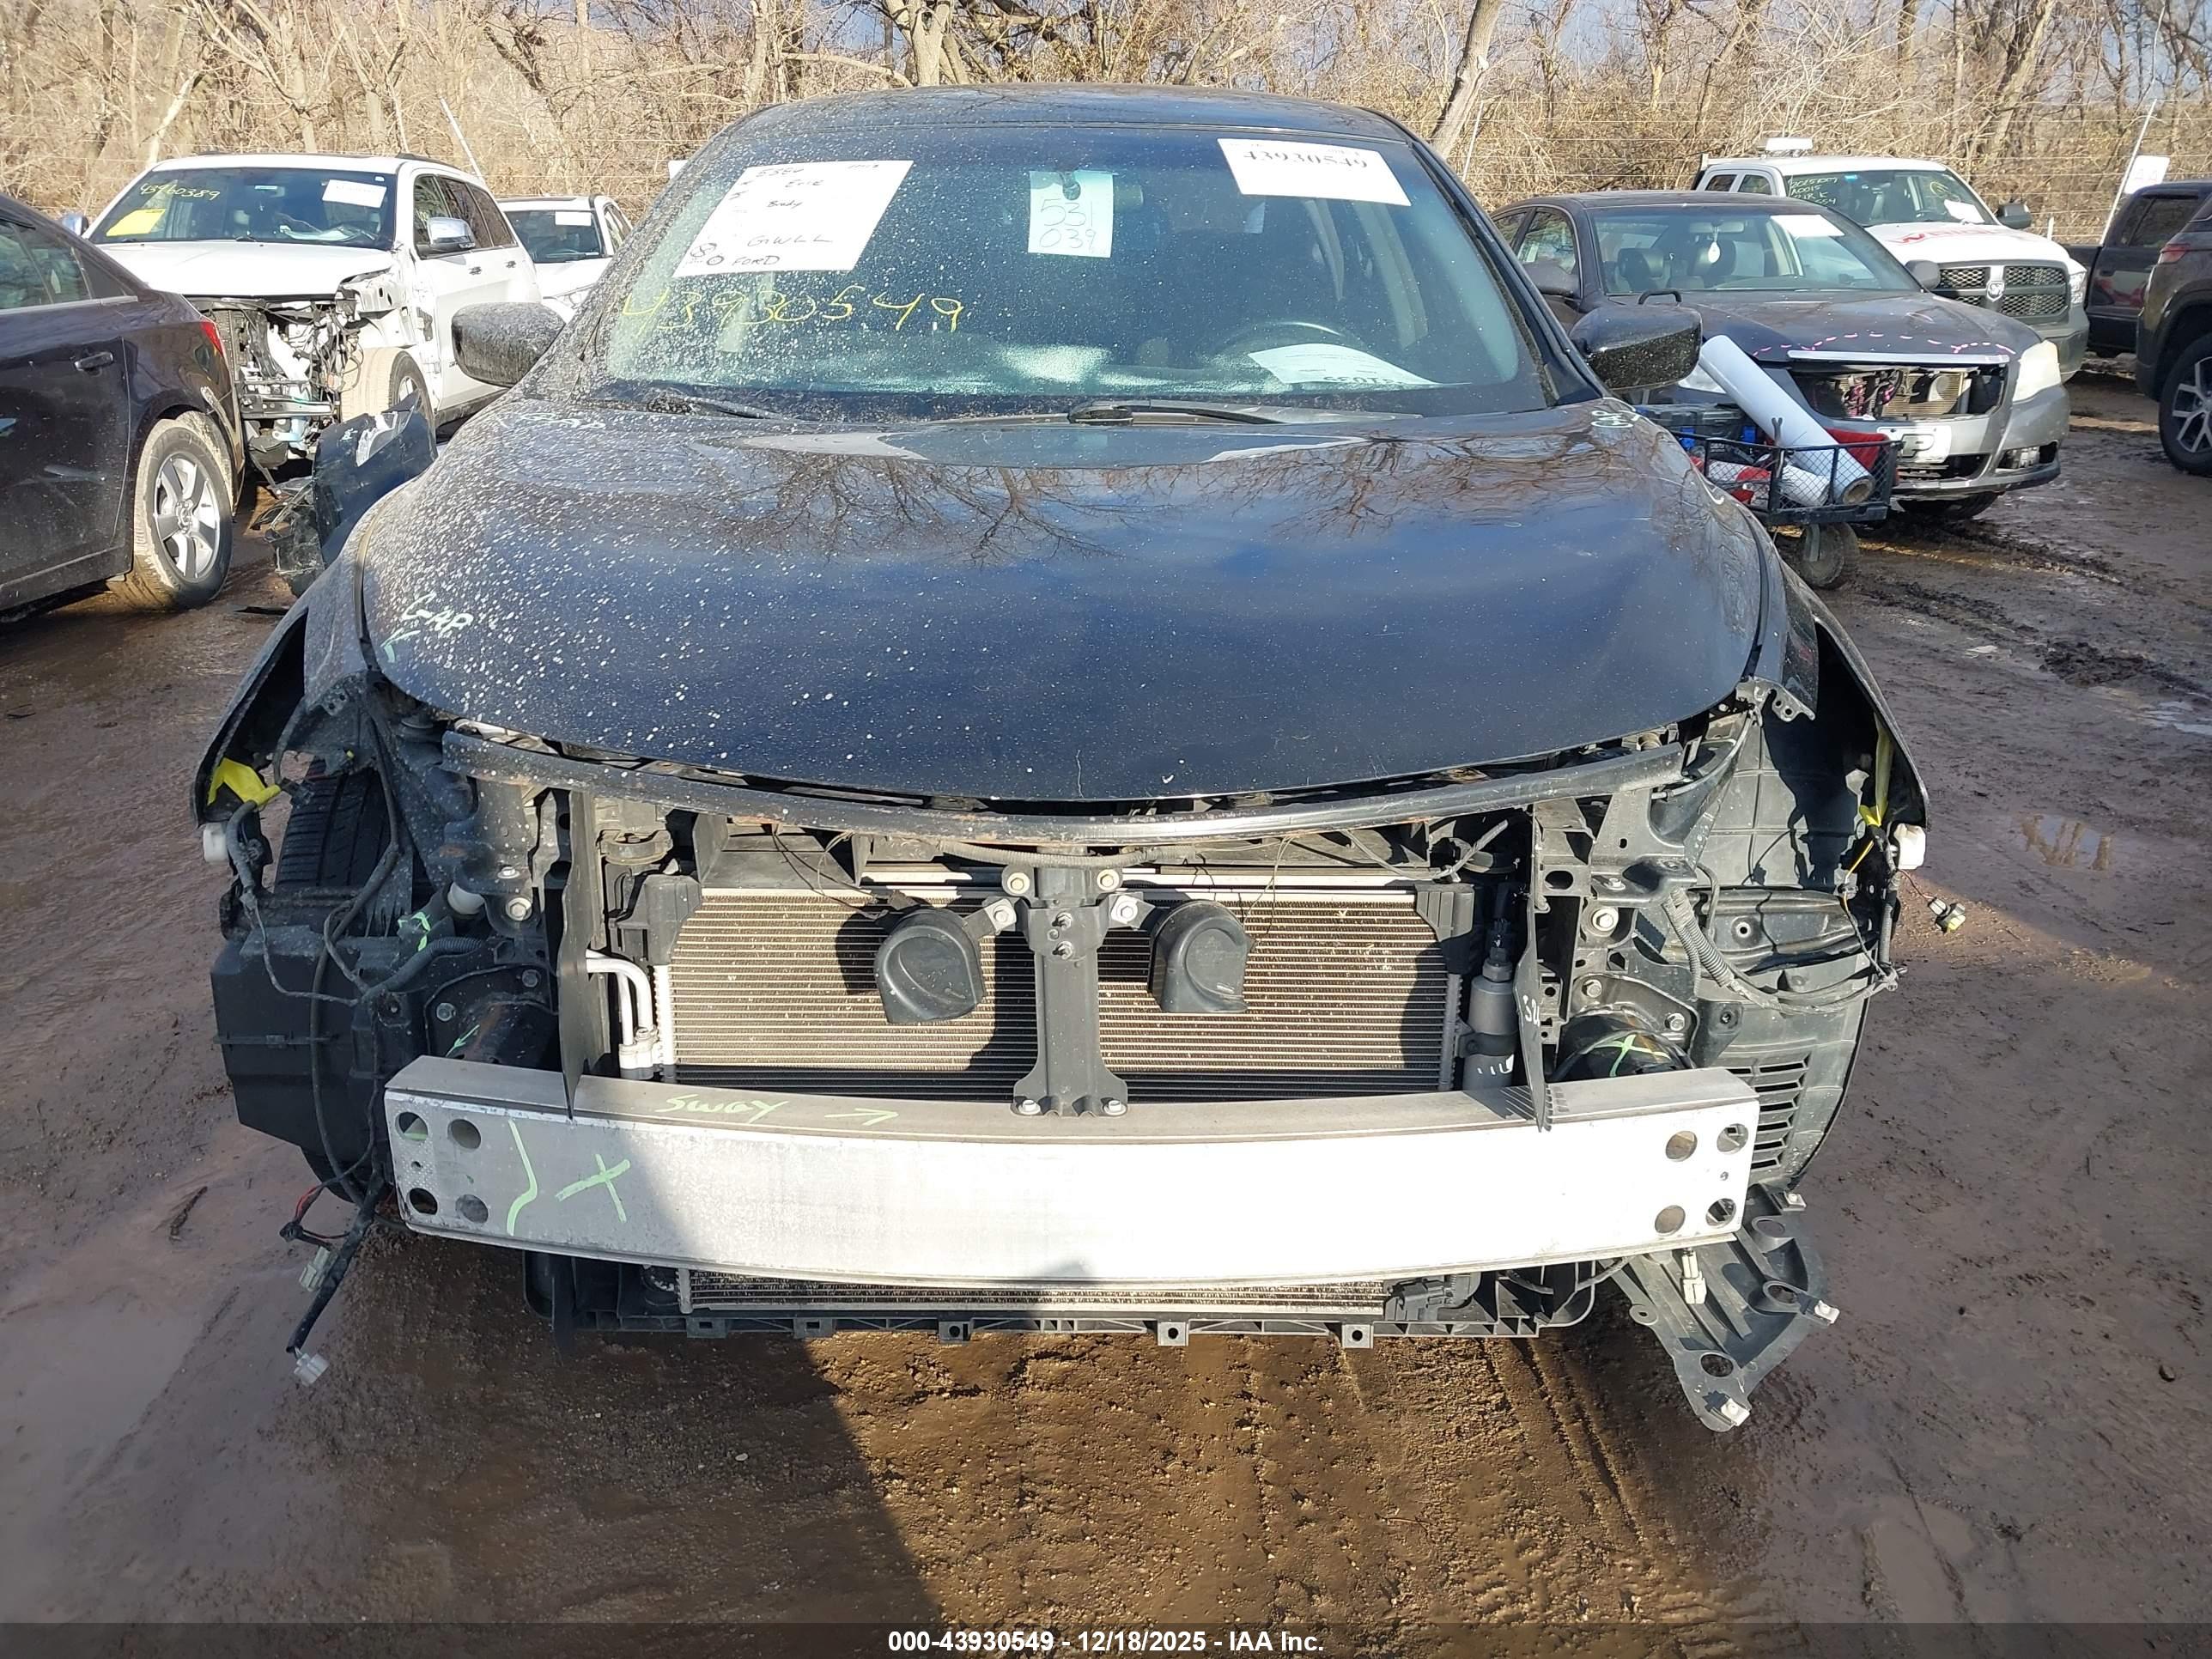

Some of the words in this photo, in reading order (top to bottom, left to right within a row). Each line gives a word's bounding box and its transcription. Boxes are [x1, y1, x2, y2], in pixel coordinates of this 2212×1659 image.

[1243, 150, 1368, 168] 43930549
[1041, 198, 1093, 227] 531
[1039, 228, 1097, 249] 039
[623, 284, 963, 337] 43930549
